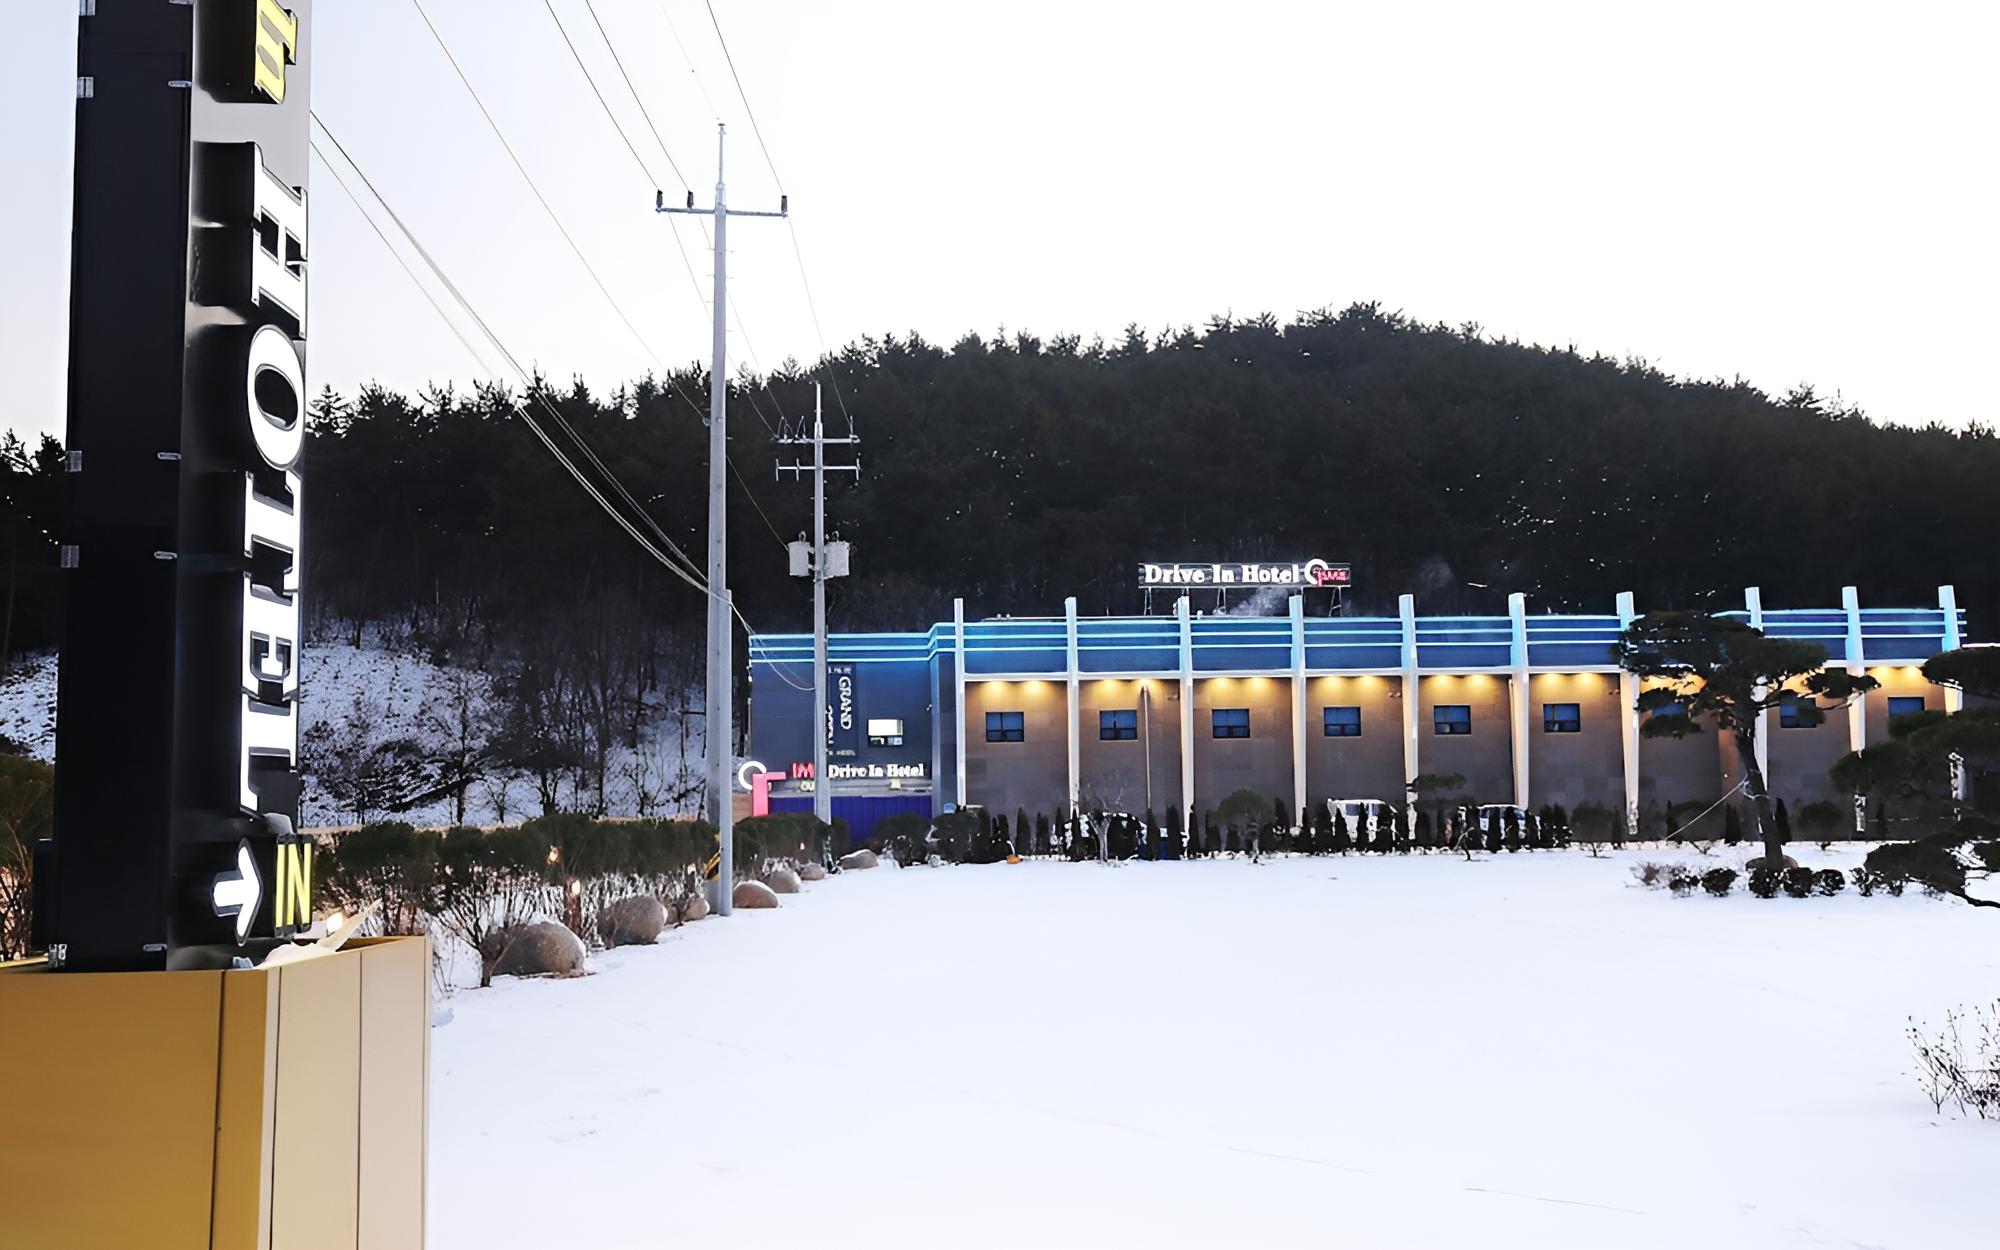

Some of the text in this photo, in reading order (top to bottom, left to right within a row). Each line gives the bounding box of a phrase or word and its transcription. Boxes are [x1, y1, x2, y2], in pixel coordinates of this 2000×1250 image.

[239, 140, 308, 813] HOTEL
[1145, 565, 1205, 583] Drive
[1212, 565, 1235, 583] In
[1241, 565, 1299, 583] Hotel
[839, 676, 851, 730] GRAND
[828, 764, 866, 778] Drive
[868, 764, 884, 777] In
[887, 763, 924, 777] Hotel
[275, 841, 313, 930] IN
